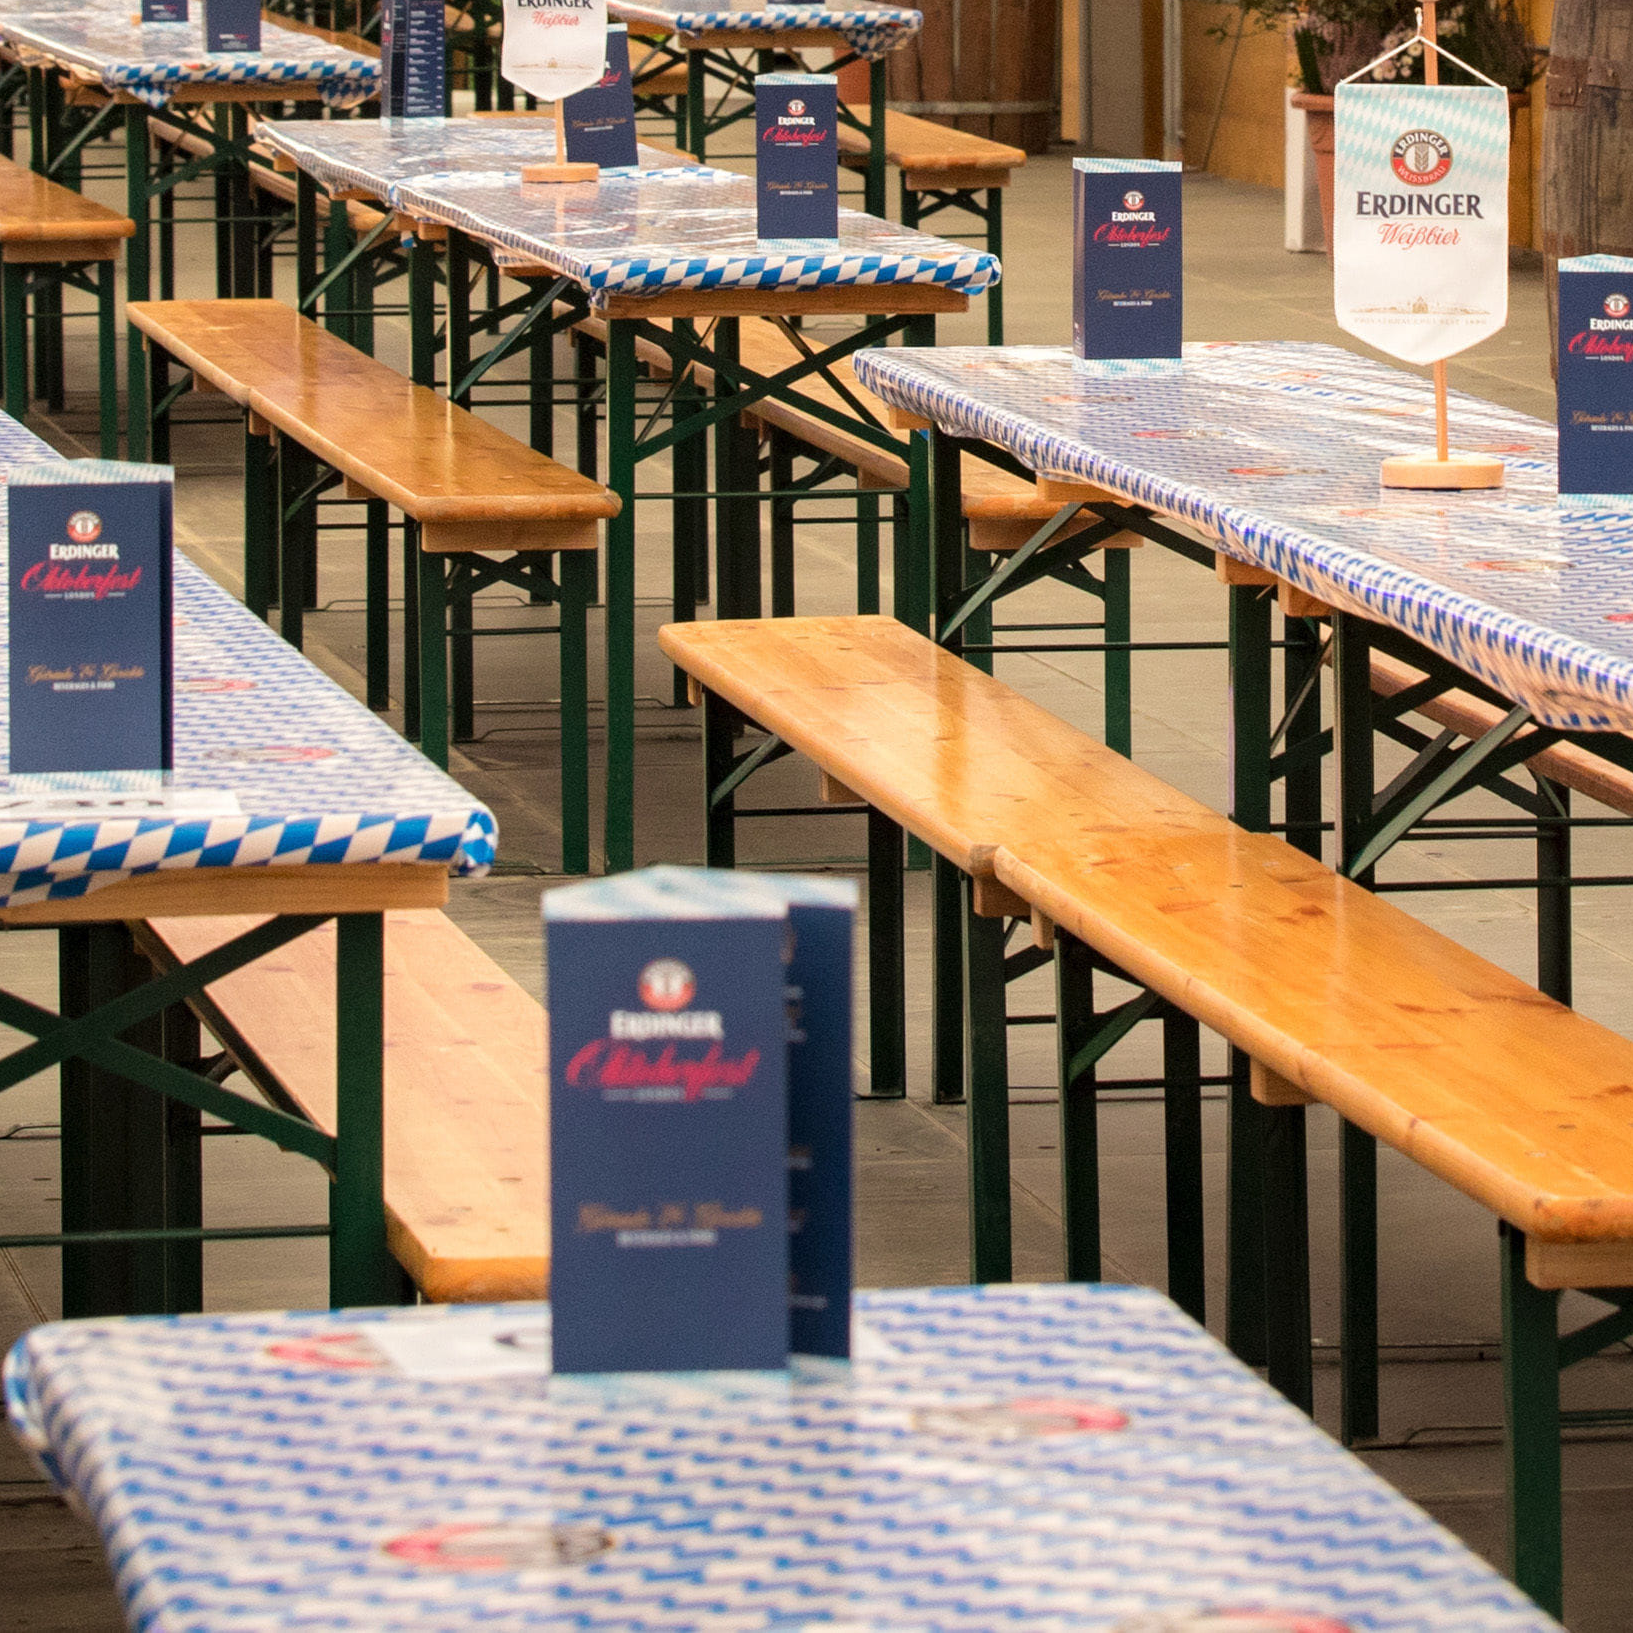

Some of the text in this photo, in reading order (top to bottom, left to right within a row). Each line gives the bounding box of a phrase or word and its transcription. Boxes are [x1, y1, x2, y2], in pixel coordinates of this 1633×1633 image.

[1395, 132, 1449, 156] ERDINGER
[1111, 211, 1156, 222] ERDINGER
[1356, 191, 1485, 219] ERDINGER
[1093, 222, 1172, 248] Oktoberfest
[1377, 222, 1462, 251] Weißbier
[49, 543, 120, 560] ERDINGER
[20, 561, 143, 600] Oktoberfest
